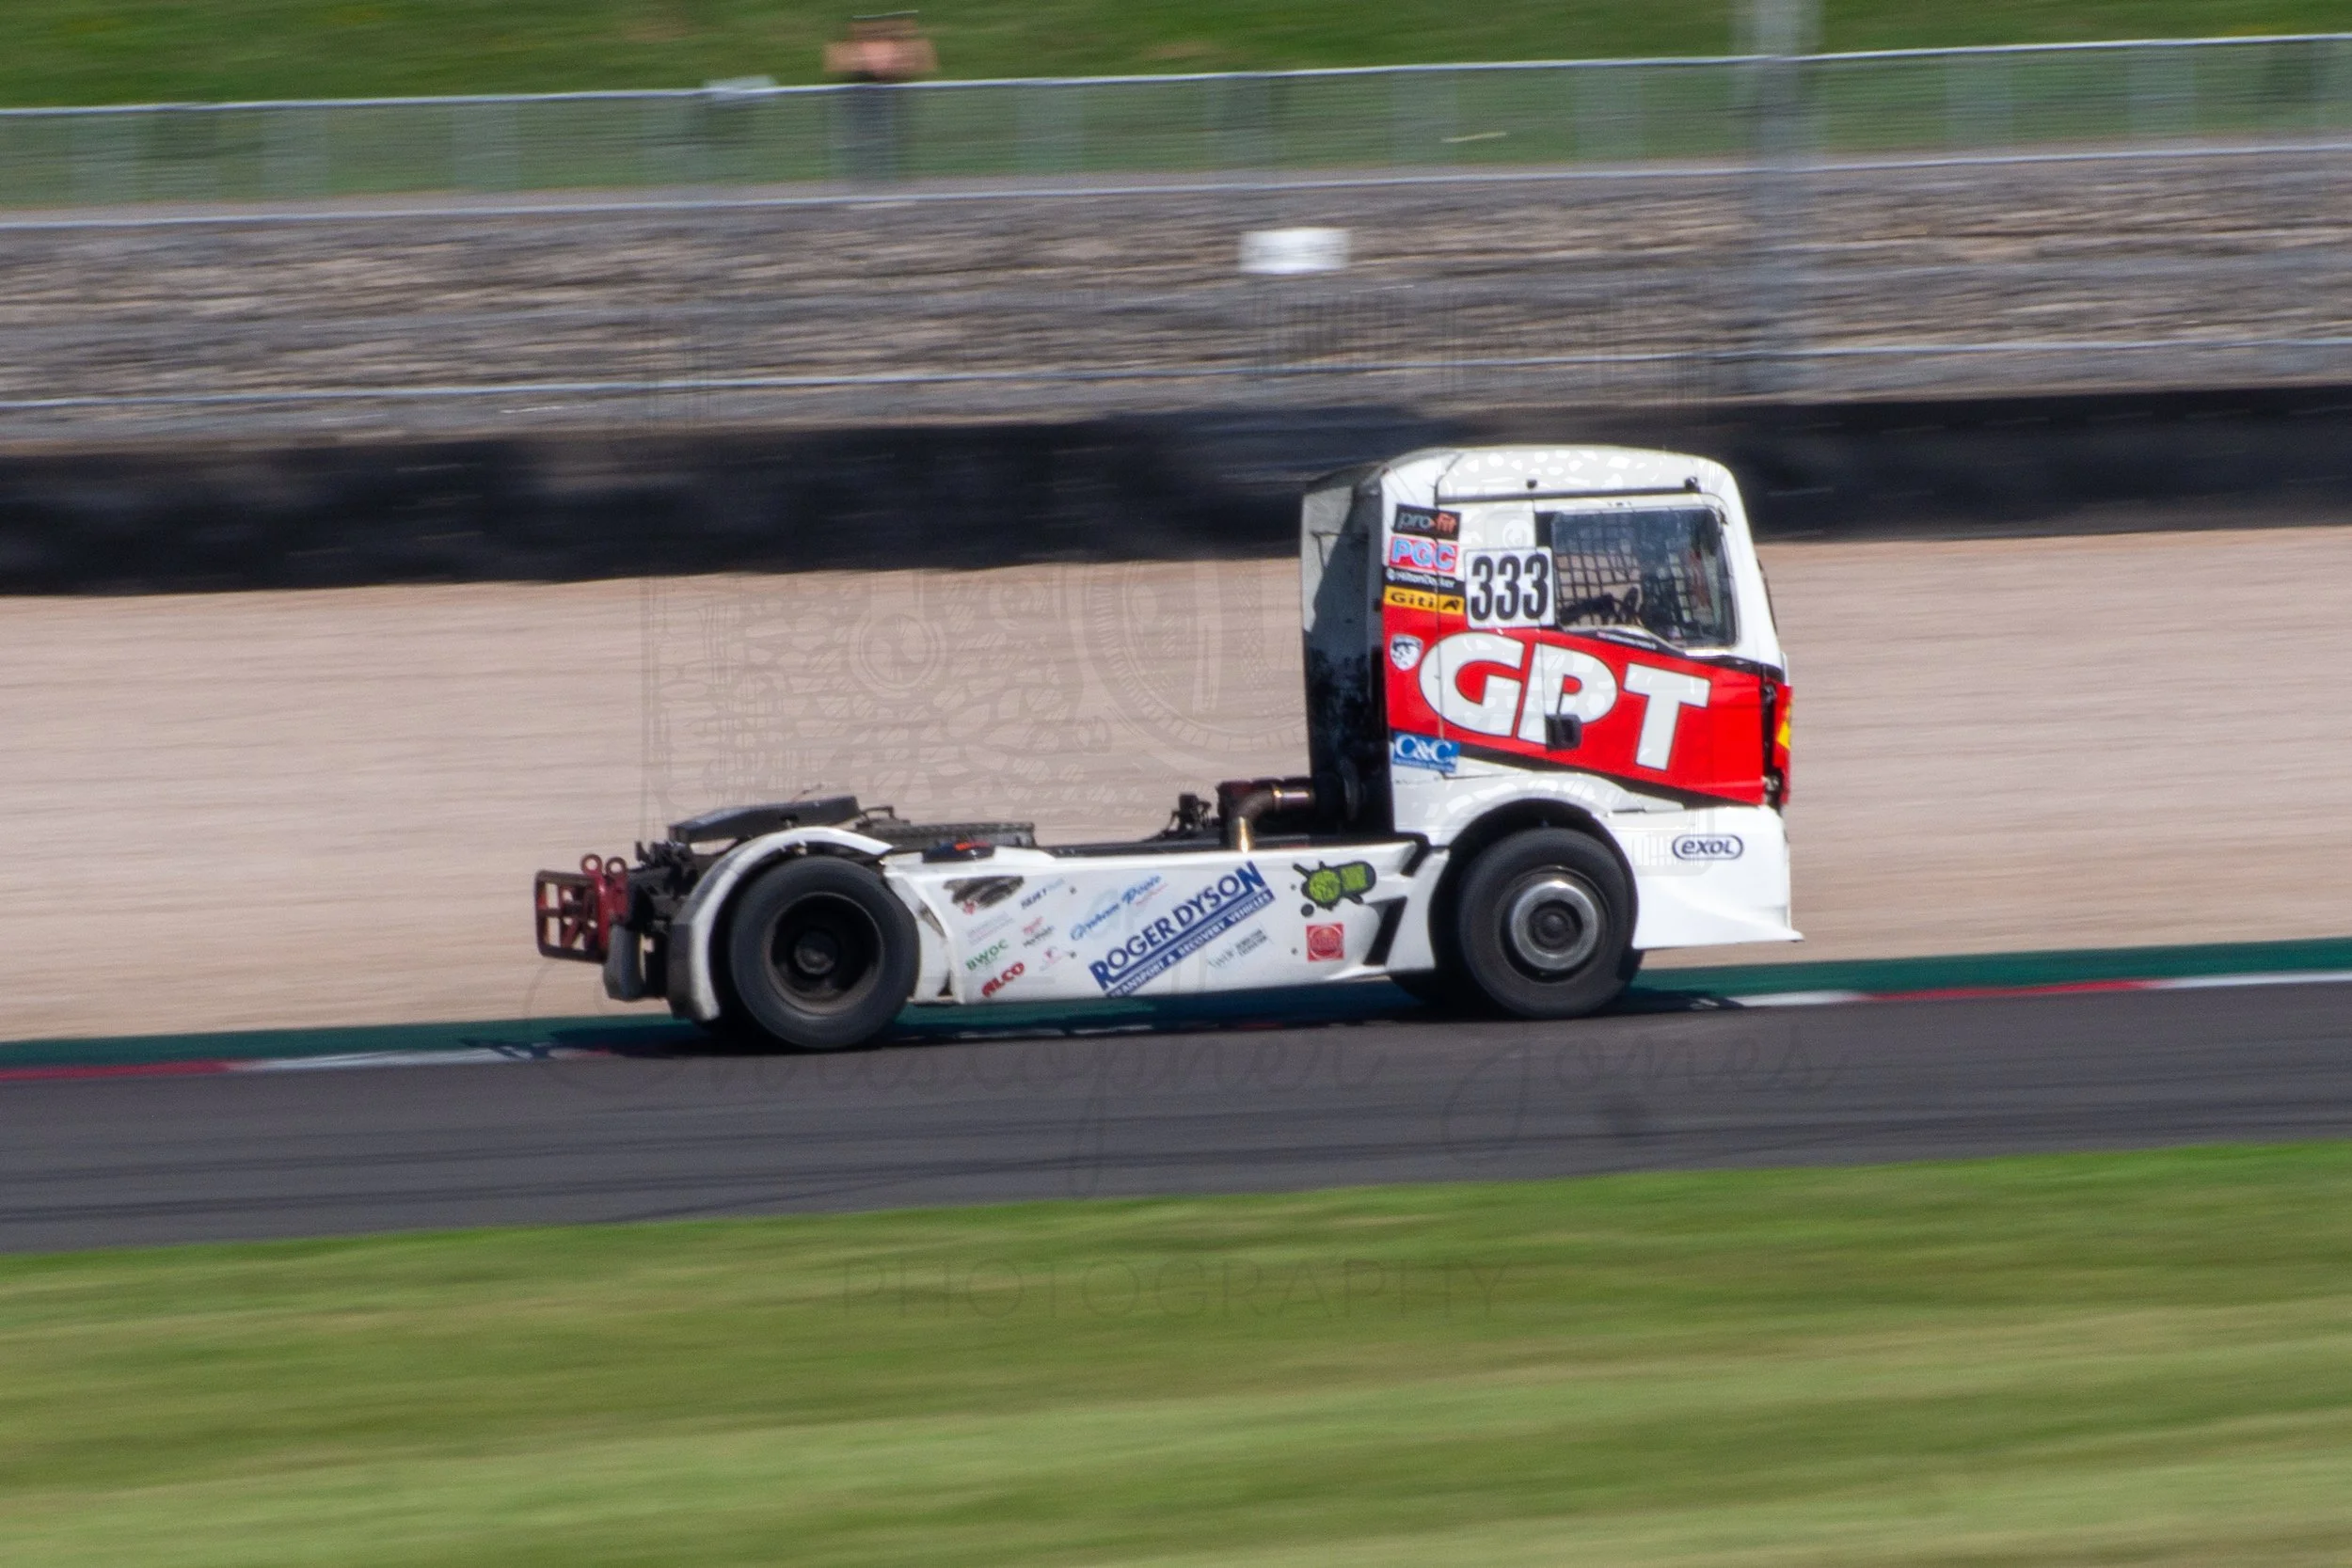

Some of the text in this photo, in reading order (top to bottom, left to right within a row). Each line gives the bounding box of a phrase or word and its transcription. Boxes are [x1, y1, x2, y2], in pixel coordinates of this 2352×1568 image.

[1391, 537, 1456, 571] PGC
[1391, 591, 1436, 609] Giti
[1470, 554, 1550, 622] 333
[1419, 631, 1710, 771] GPT
[1395, 734, 1454, 765] C&C
[1087, 912, 1180, 990] ROGER
[1172, 859, 1265, 927] DYSON
[1177, 920, 1228, 957] RECOVERY
